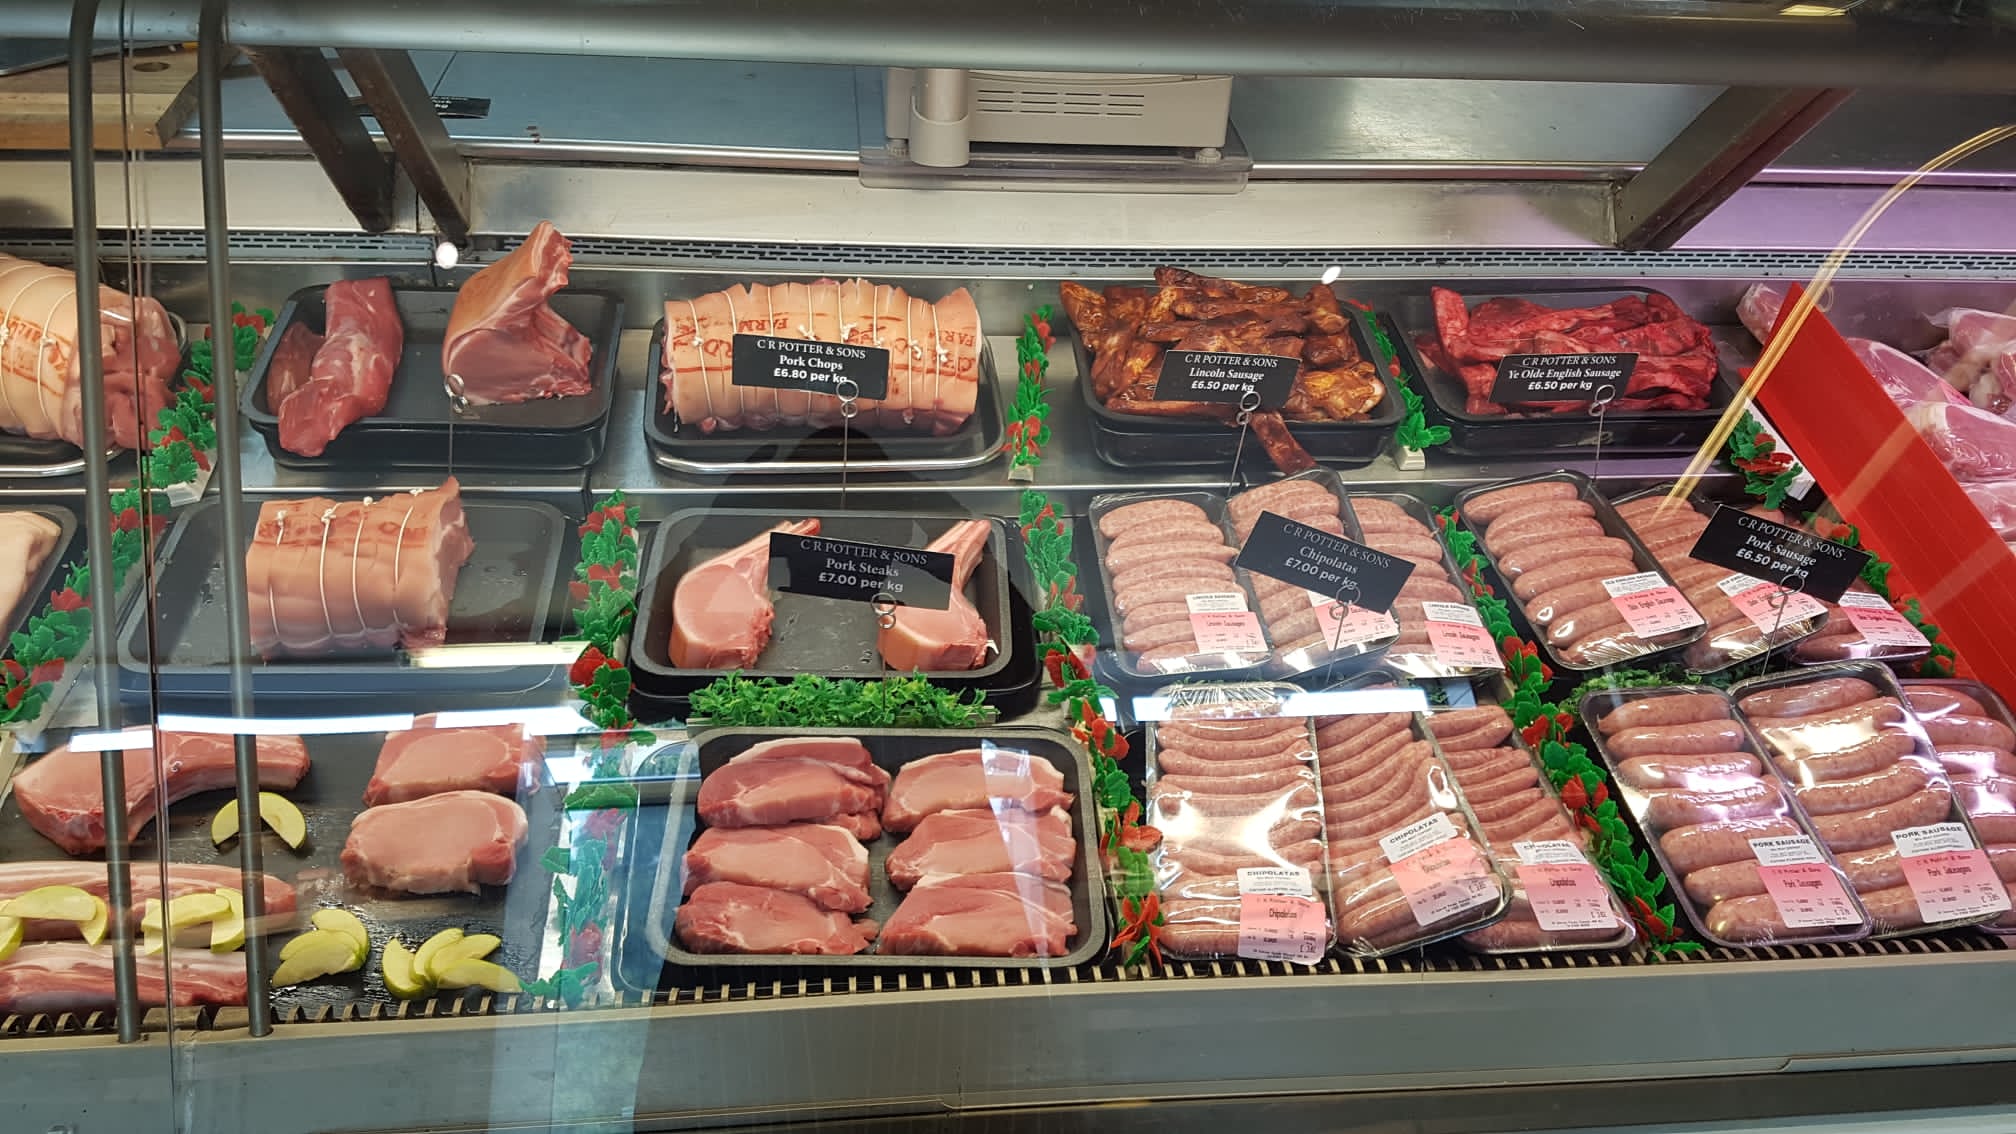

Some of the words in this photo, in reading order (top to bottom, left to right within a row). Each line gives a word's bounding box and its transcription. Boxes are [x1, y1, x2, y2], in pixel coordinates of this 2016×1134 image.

[757, 340, 765, 348] C
[767, 341, 776, 350] R
[778, 342, 823, 355] POTTER
[826, 347, 834, 355] &
[837, 348, 866, 359] SONS
[780, 355, 805, 366] Pork
[808, 358, 843, 372] Chops
[1185, 354, 1193, 363] C
[1194, 354, 1201, 363] R
[1202, 355, 1243, 366] POTTER
[1252, 358, 1278, 368] SONS
[1522, 357, 1531, 366] C
[1532, 357, 1538, 366] R
[1541, 356, 1579, 365] POTTER
[1581, 356, 1589, 364] &
[1590, 356, 1616, 364] SONS
[774, 368, 807, 379] £6.80
[811, 373, 830, 382] per
[1189, 368, 1226, 378] Lincoln
[1226, 370, 1264, 382] Sausage
[1509, 370, 1519, 379] Ye
[1521, 369, 1545, 379] Olde
[1546, 369, 1582, 381] English
[1584, 369, 1621, 379] Sausage
[1191, 380, 1220, 389] £6.50
[1241, 383, 1254, 392] kg
[1528, 381, 1558, 390] £6.50
[1560, 382, 1578, 391] per
[1580, 381, 1592, 390] kg
[1738, 516, 1748, 527] C
[1748, 519, 1758, 530] R
[1758, 523, 1802, 544] POTTER
[1803, 537, 1813, 547] &
[800, 539, 811, 550] C
[814, 541, 823, 552] R
[826, 543, 878, 558] POTTER
[880, 551, 890, 560] &
[894, 552, 928, 565] SONS
[1283, 523, 1293, 534] C
[1293, 526, 1302, 537] R
[1304, 530, 1348, 555] POTTER
[1349, 547, 1360, 557] &
[1360, 550, 1391, 569] SONS
[1746, 535, 1771, 552] Pork
[1774, 544, 1817, 566] Sausage
[826, 558, 856, 571] Pork
[860, 562, 899, 577] Steaks
[1299, 546, 1359, 574] Chipolatas
[1736, 548, 1771, 566] £6.50
[1771, 560, 1793, 573] per
[819, 572, 857, 585] £7.00
[860, 579, 884, 589] per
[888, 580, 904, 593] kg
[1285, 557, 1319, 575] £7.00
[1320, 570, 1342, 583] per
[1343, 576, 1357, 590] kg
[1390, 818, 1439, 844] CHIPOLATAS
[1922, 826, 1964, 835] SAUSAGE
